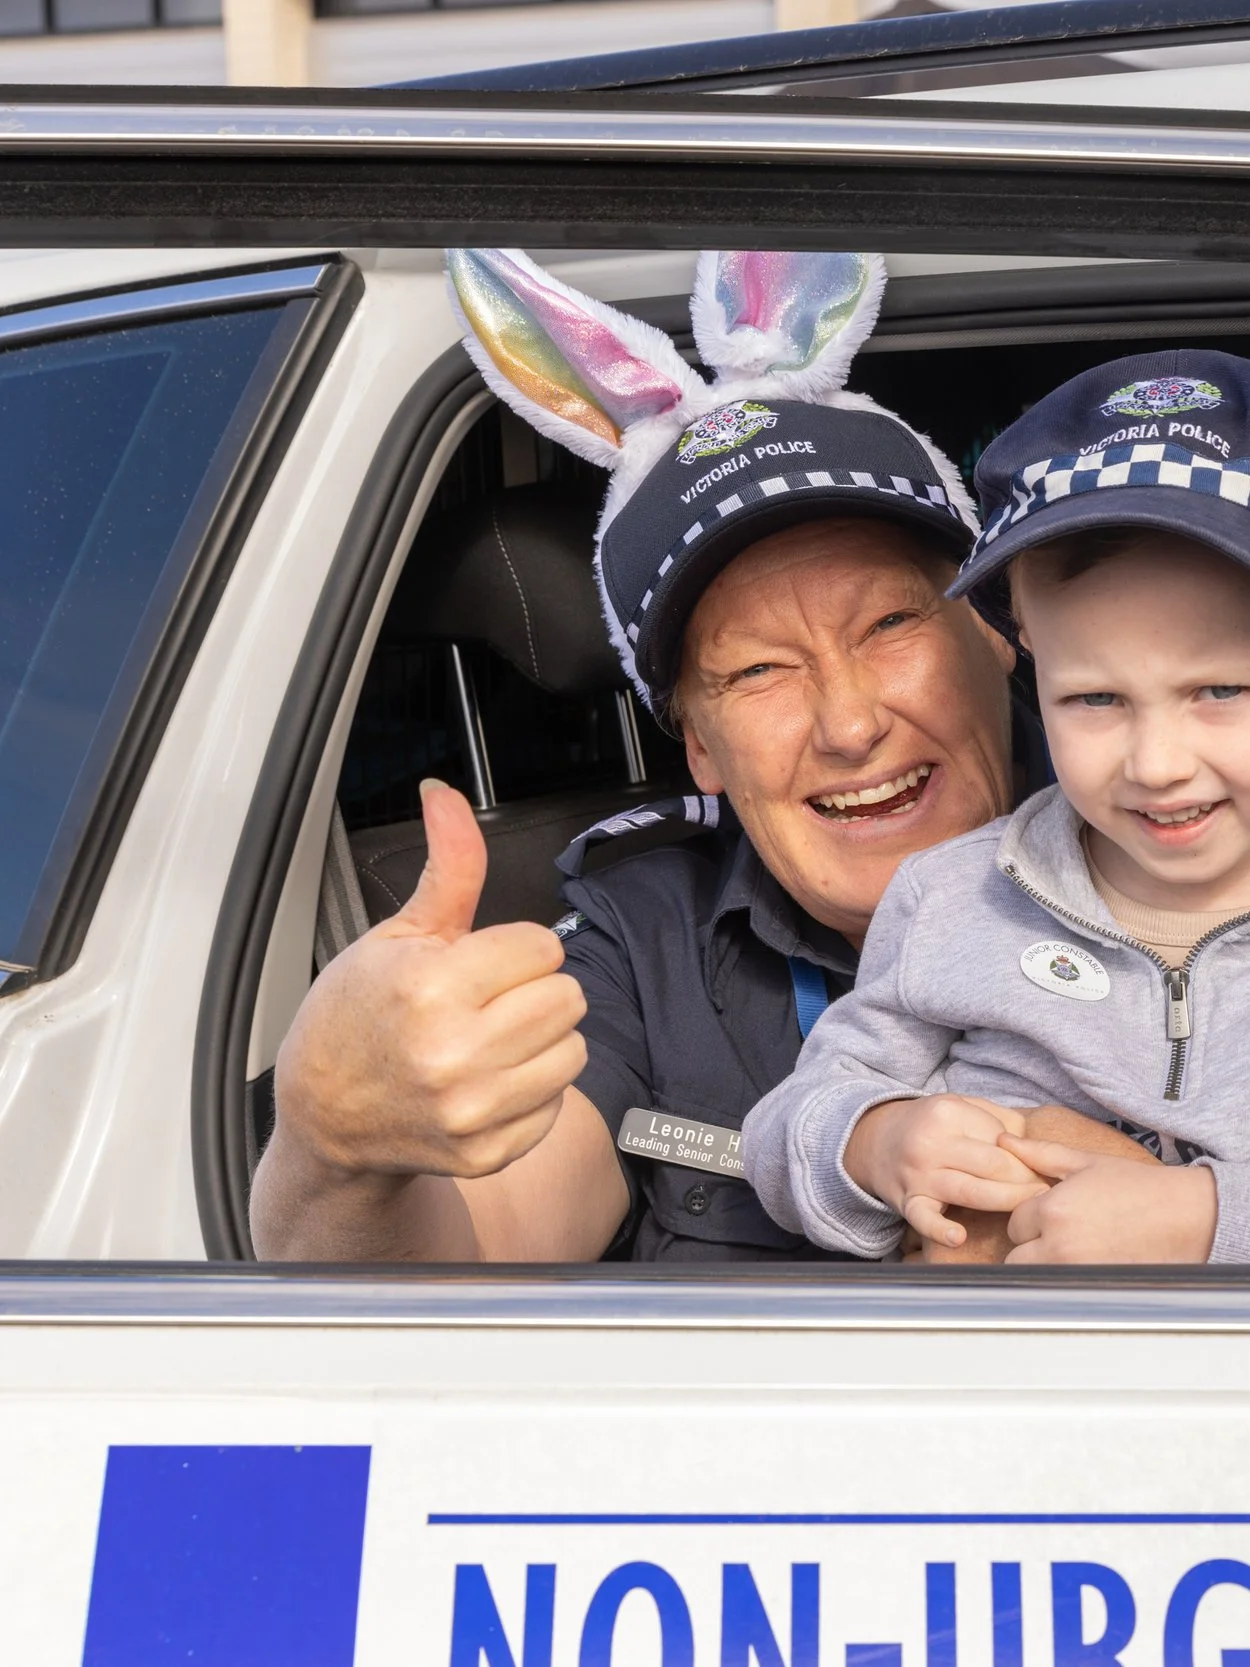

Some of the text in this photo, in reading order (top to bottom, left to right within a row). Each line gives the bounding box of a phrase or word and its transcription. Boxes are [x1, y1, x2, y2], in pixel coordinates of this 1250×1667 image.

[1079, 422, 1231, 459] VICTORIA POLICE
[680, 441, 817, 504] VICTORIA POLICE
[1024, 944, 1104, 975] JUNIOR CONSTABLE
[625, 1132, 671, 1157] Leading
[676, 1144, 714, 1163] Senior
[649, 1116, 741, 1153] Leonie H
